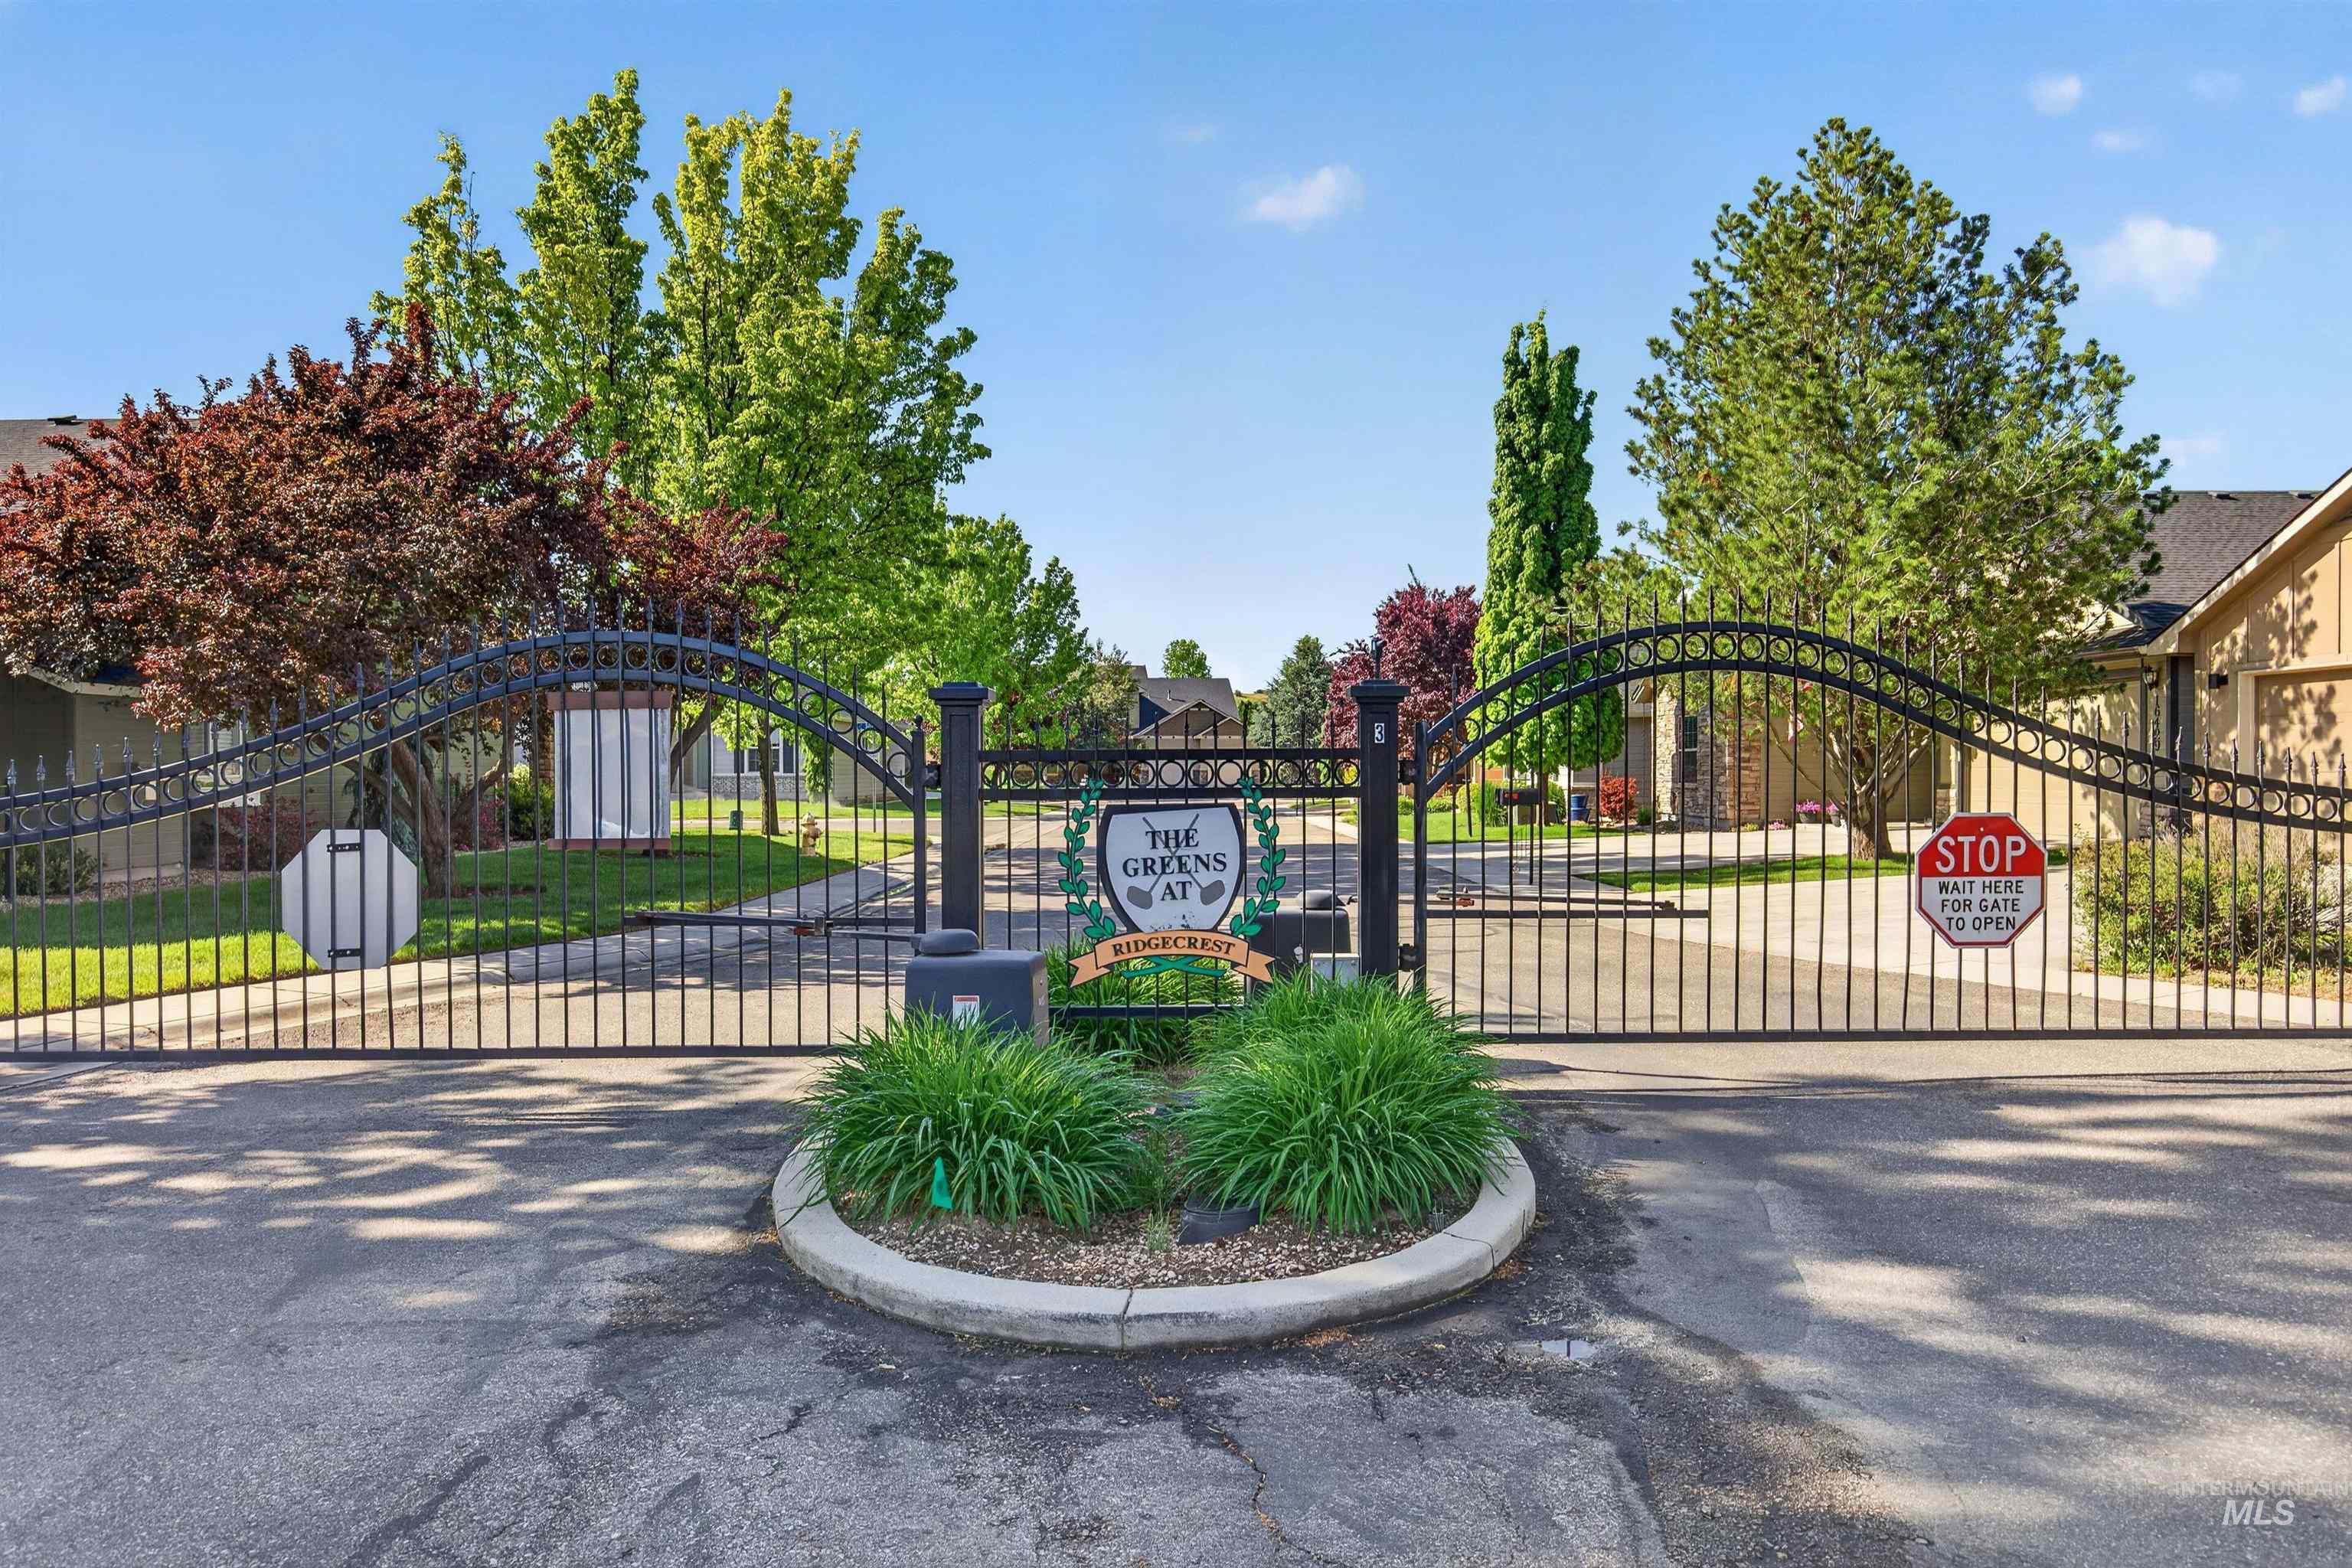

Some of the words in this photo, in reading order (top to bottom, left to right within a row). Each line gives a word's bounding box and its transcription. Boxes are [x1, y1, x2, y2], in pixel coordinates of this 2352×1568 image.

[1375, 724, 1383, 742] 3
[1145, 828, 1200, 850] THE
[1122, 852, 1227, 877] GREENS
[1935, 835, 2027, 873] STOP
[1161, 880, 1193, 901] AT
[1939, 880, 1975, 895] WAIT
[1982, 880, 2024, 894] HERE
[1941, 899, 1972, 913] FOR
[1979, 898, 2020, 912] GATE
[1945, 917, 1965, 932] TO
[1972, 916, 2016, 931] OPEN
[1112, 936, 1236, 957] RIDGECREST
